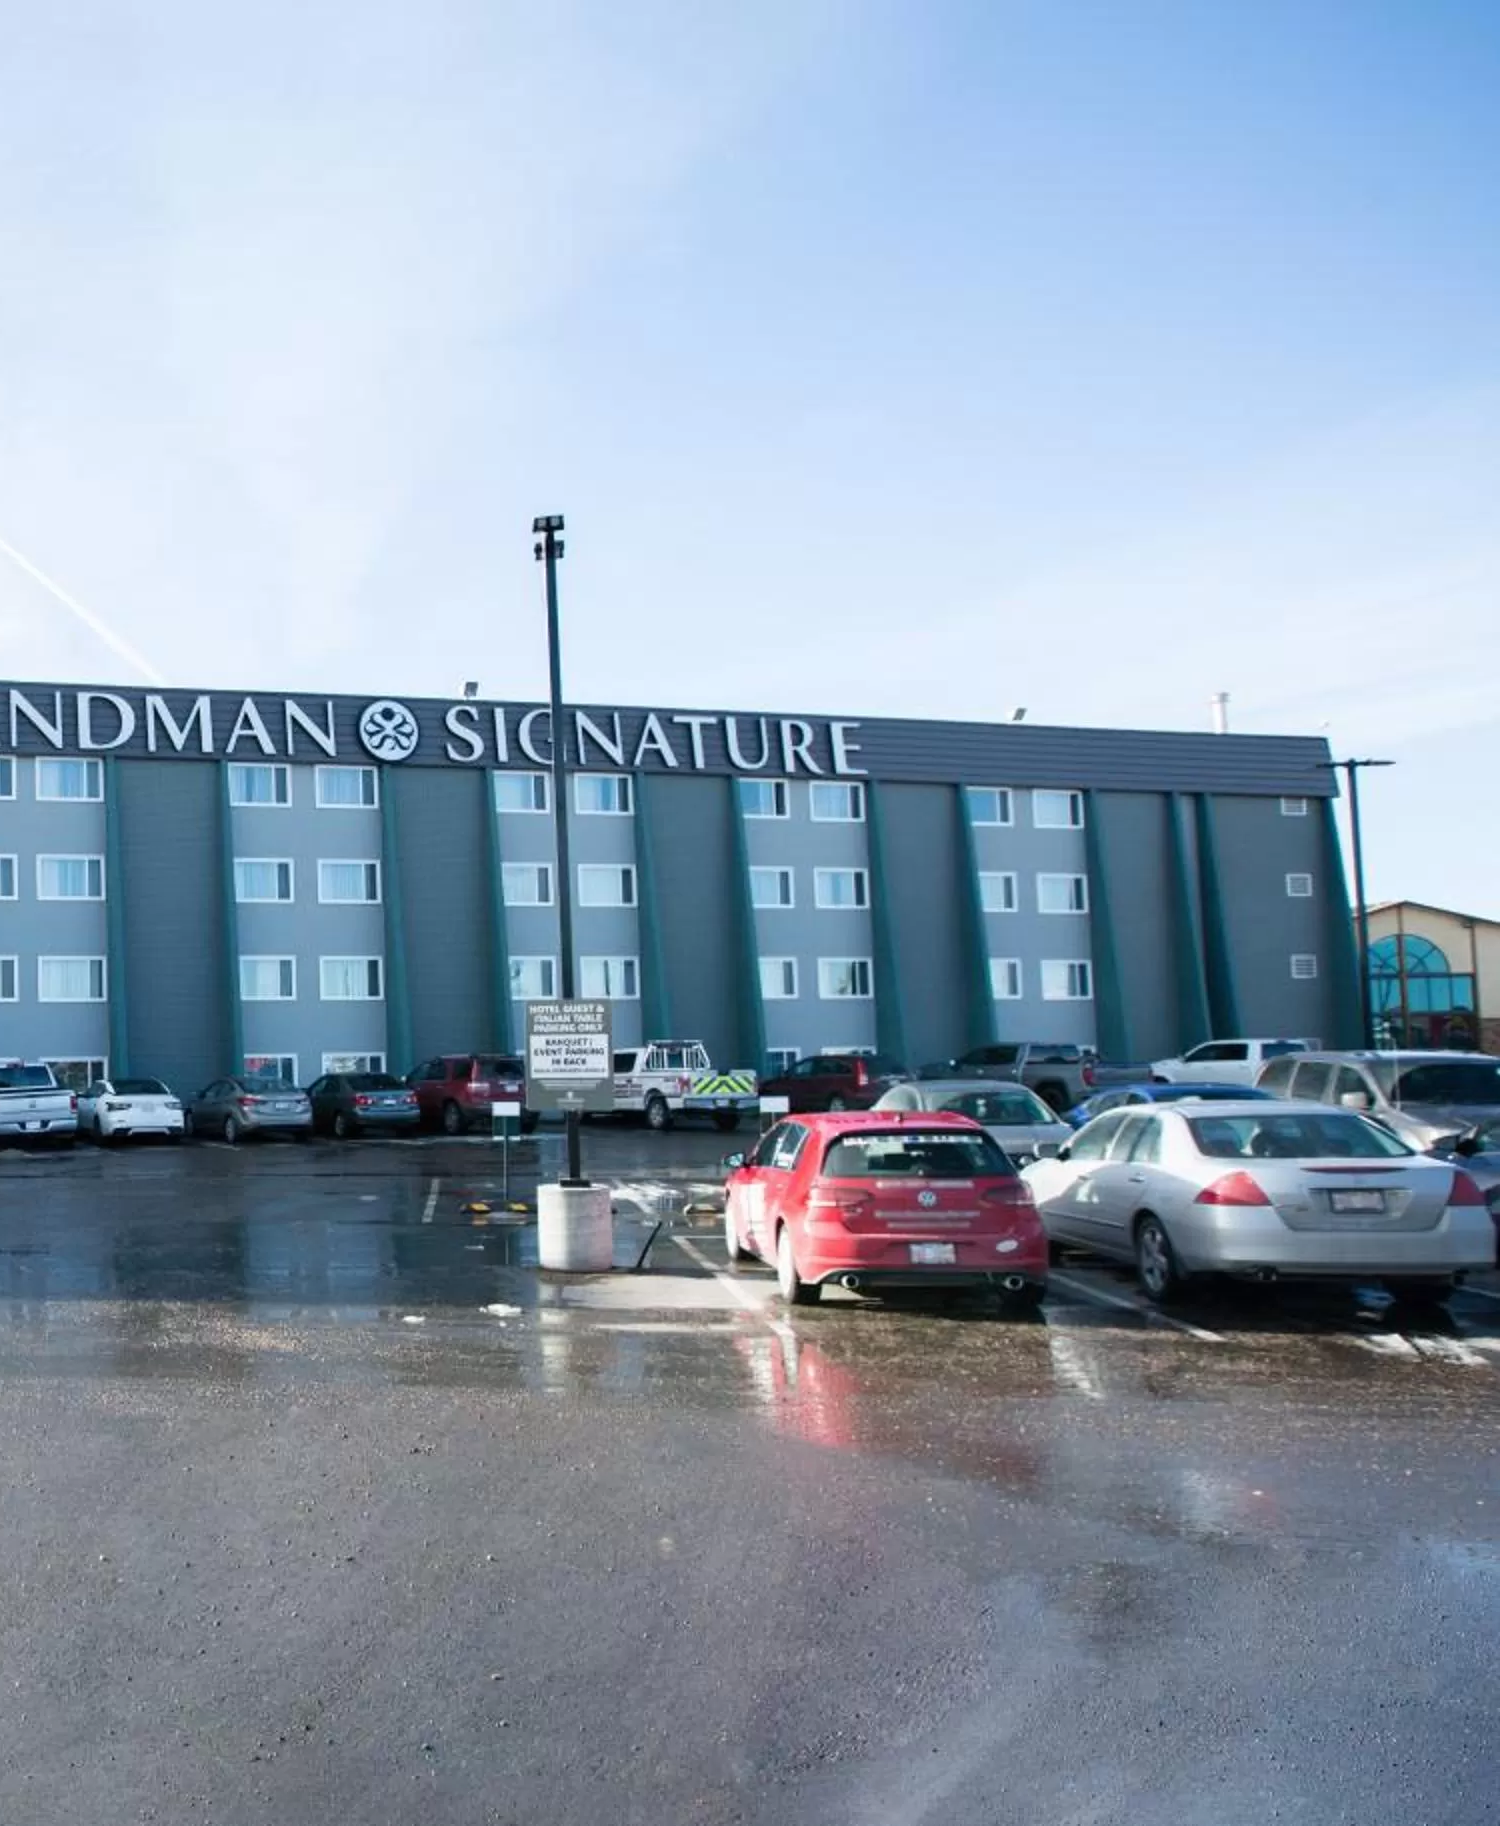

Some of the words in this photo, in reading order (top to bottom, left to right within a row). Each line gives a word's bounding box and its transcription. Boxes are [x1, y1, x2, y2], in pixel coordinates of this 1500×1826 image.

[445, 705, 869, 775] SIGNATURE
[529, 1004, 559, 1014] HOTEL
[533, 1047, 562, 1056] EVENT
